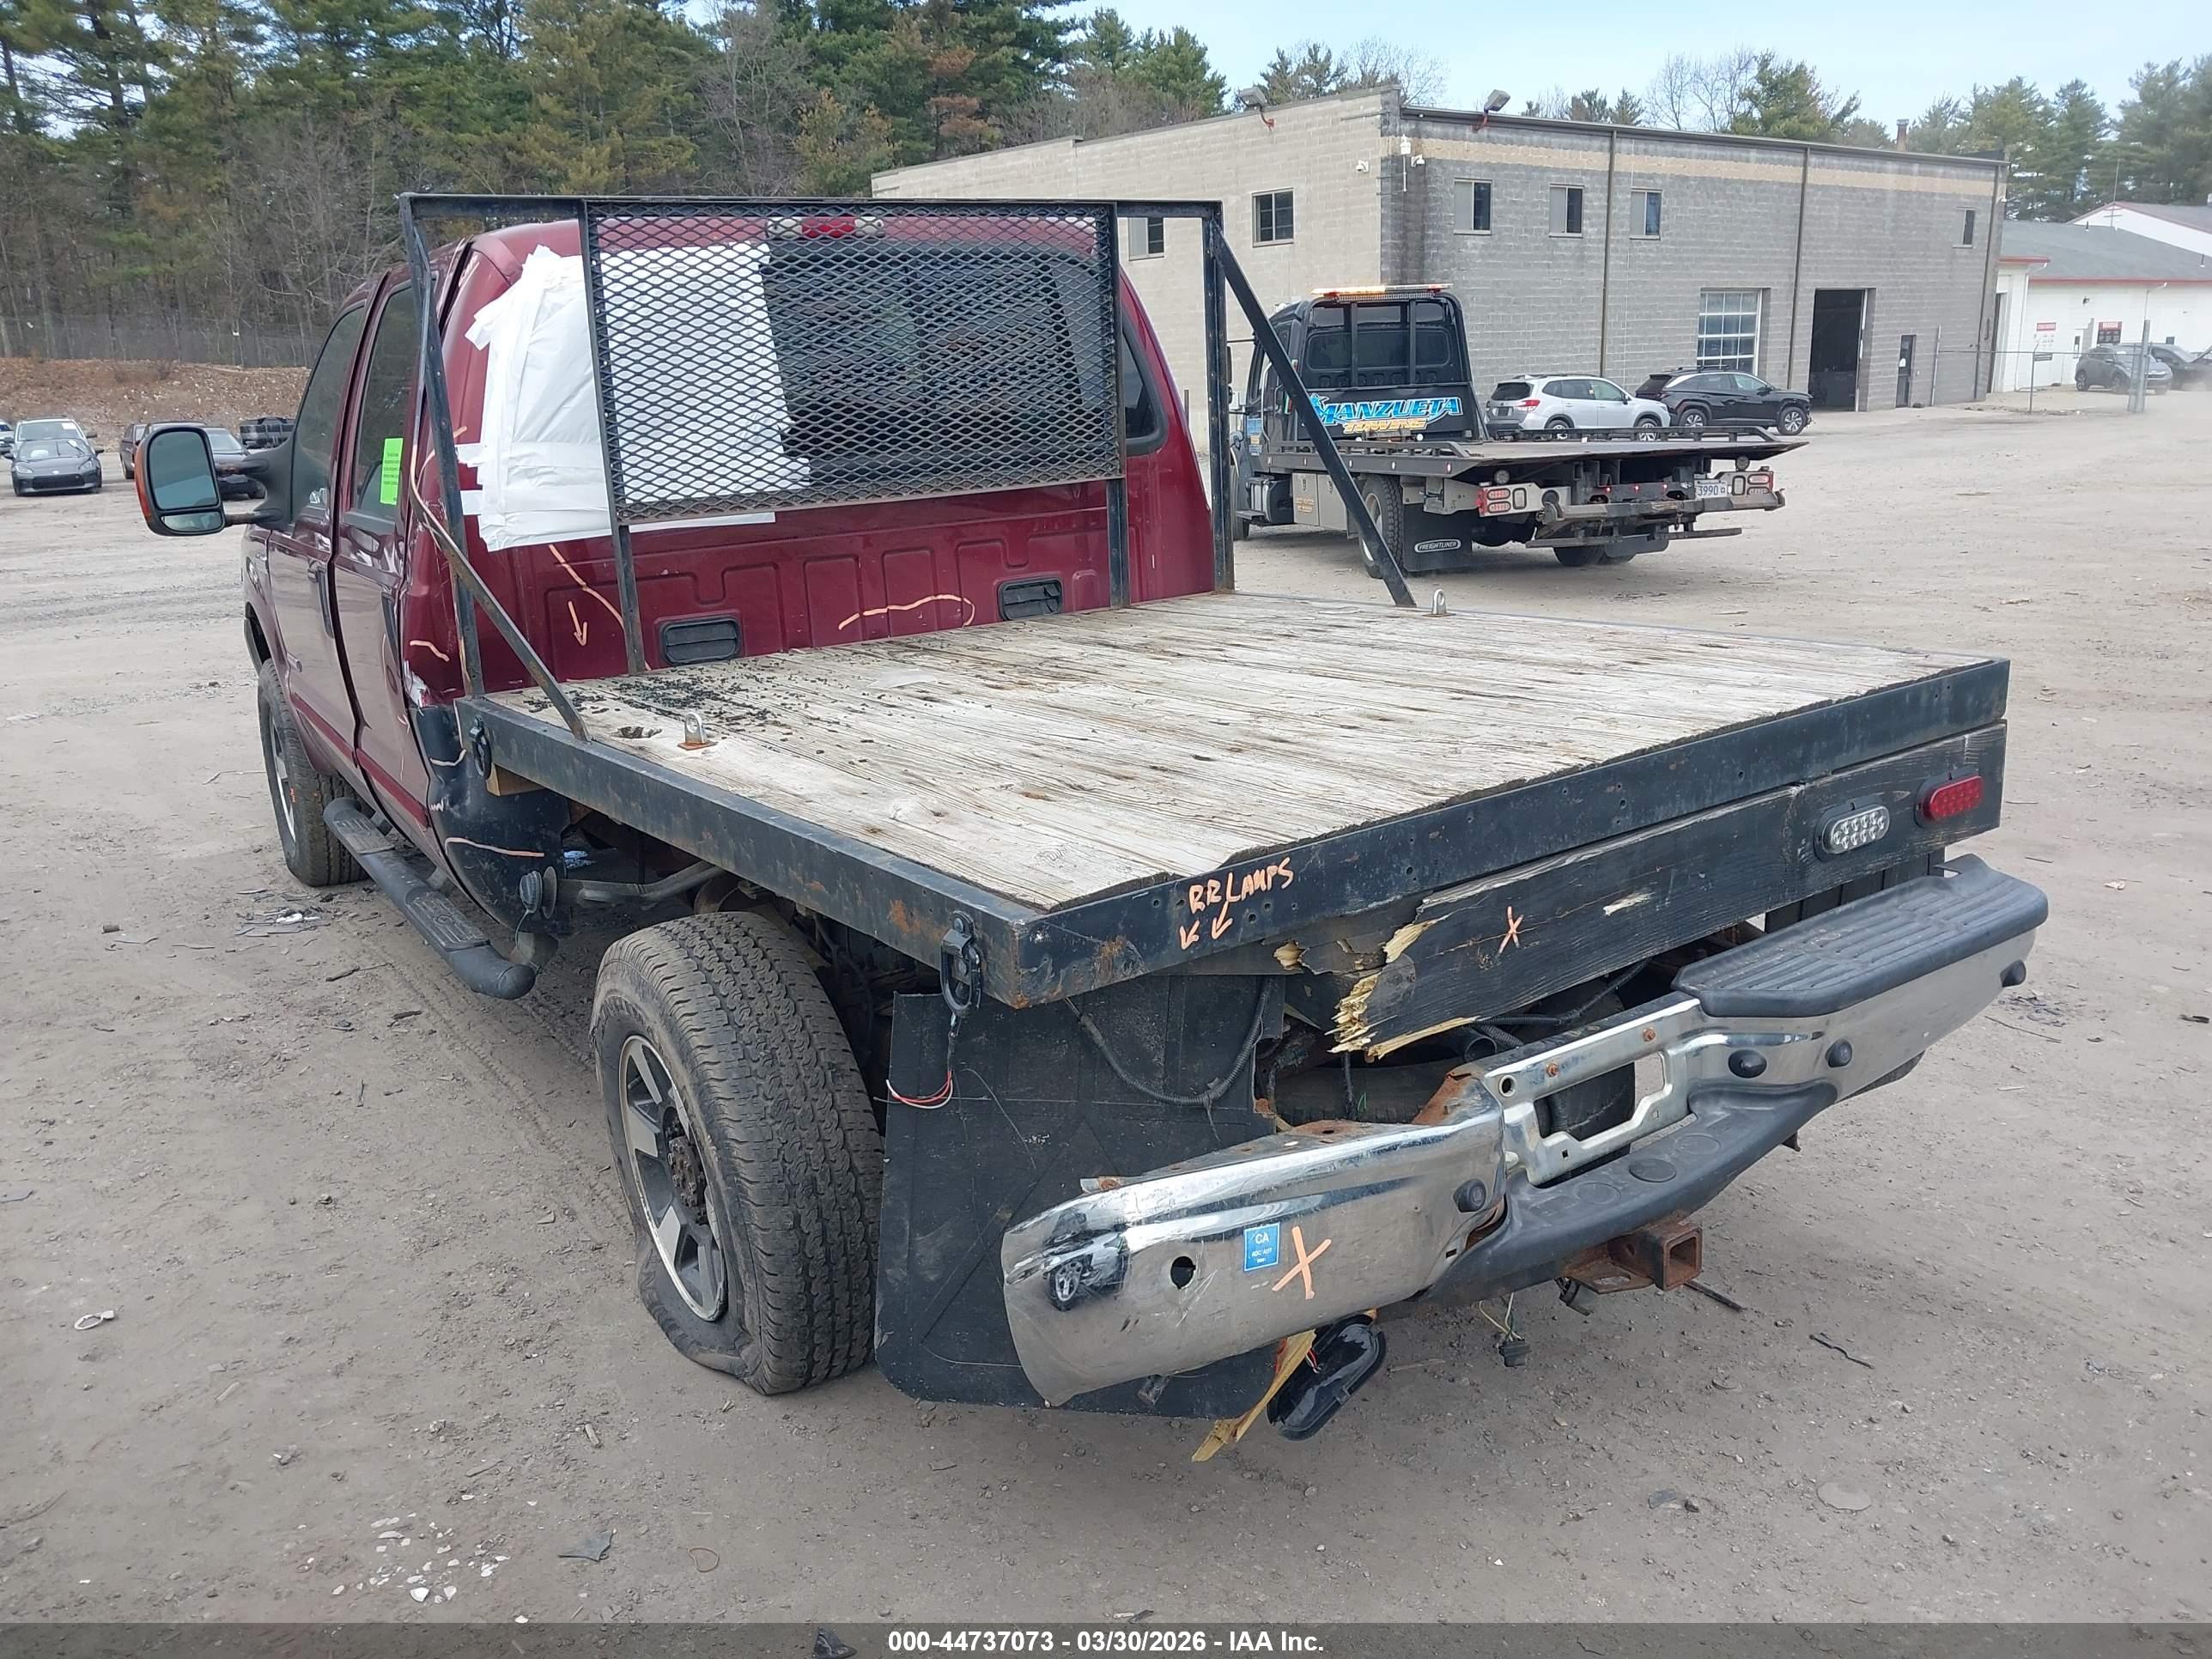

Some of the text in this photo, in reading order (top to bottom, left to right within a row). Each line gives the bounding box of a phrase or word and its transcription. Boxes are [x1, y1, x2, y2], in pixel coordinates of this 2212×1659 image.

[1314, 397, 1463, 426] MANZUETA
[1344, 418, 1427, 434] TOWING
[1419, 541, 1457, 550] FREIGHTLINER
[1226, 857, 1294, 902] LAMPS
[1255, 1231, 1270, 1244] CA
